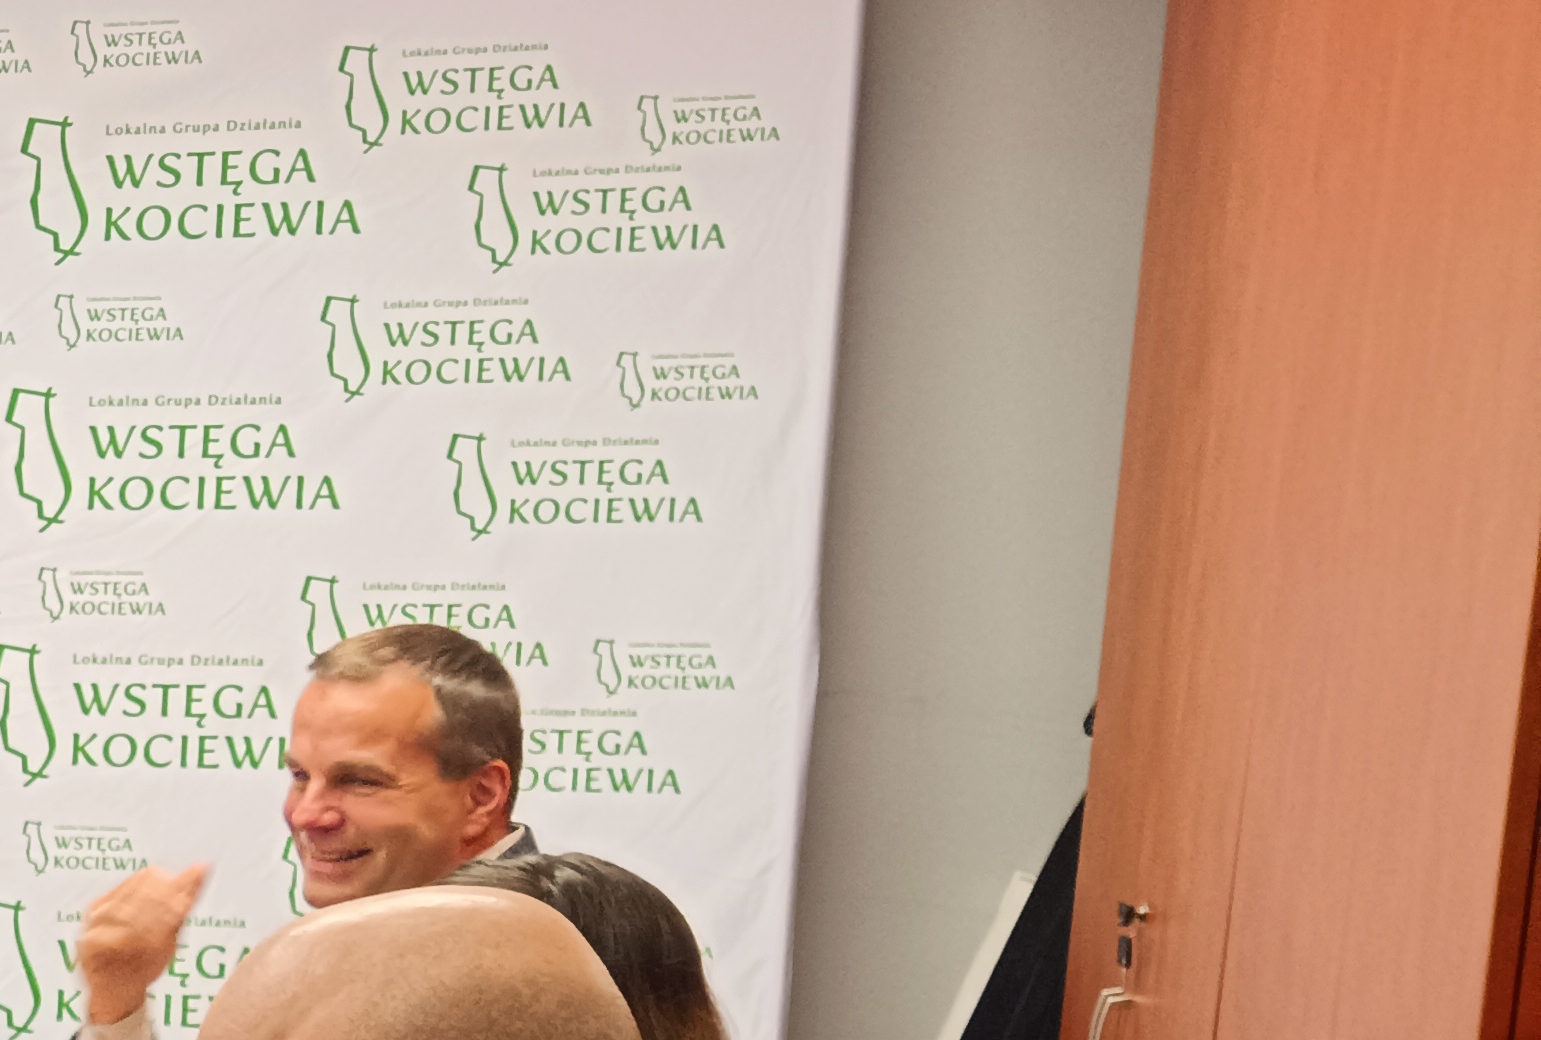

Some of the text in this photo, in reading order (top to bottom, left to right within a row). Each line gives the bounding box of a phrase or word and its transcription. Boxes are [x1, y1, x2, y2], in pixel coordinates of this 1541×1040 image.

[104, 30, 185, 49] WSTĘGA
[103, 50, 202, 68] KOCIEWIA
[402, 64, 559, 100] WSTĘGA
[105, 118, 302, 136] Lokalna Grupa Działania
[401, 101, 592, 135] KOCIEWIA
[673, 106, 762, 125] WSTĘGA
[672, 127, 780, 145] KOCIEWIA
[106, 148, 316, 196] WSTĘGA
[533, 185, 692, 221] WSTĘGA
[104, 199, 361, 241] KOCIEWIA
[531, 223, 725, 255] KOCIEWIA
[87, 307, 167, 325] WSTĘGA
[86, 327, 184, 342] KOCIEWIA
[383, 319, 539, 353] WSTĘGA
[382, 356, 571, 385] KOCIEWIA
[652, 364, 740, 383] WSTĘGA
[88, 394, 282, 409] Lokalna Grupa Działania
[651, 385, 759, 402] KOCIEWIA
[89, 424, 296, 469] WSTĘGA
[511, 459, 669, 493] WSTĘGA
[88, 475, 340, 511] KOCIEWIA
[509, 497, 703, 524] KOCIEWIA
[70, 581, 149, 599] WSTĘGA
[69, 601, 166, 616] KOCIEWIA
[72, 653, 264, 668] Lokalna Grupa Działania
[629, 654, 716, 673] WSTĘGA
[627, 675, 735, 690] KOCIEWIA
[73, 683, 277, 728] WSTĘGA
[71, 731, 287, 770] KOCIEWI
[528, 728, 648, 763] STĘGA
[520, 765, 682, 795] OCIEWIA
[55, 836, 133, 854] WSTĘGA
